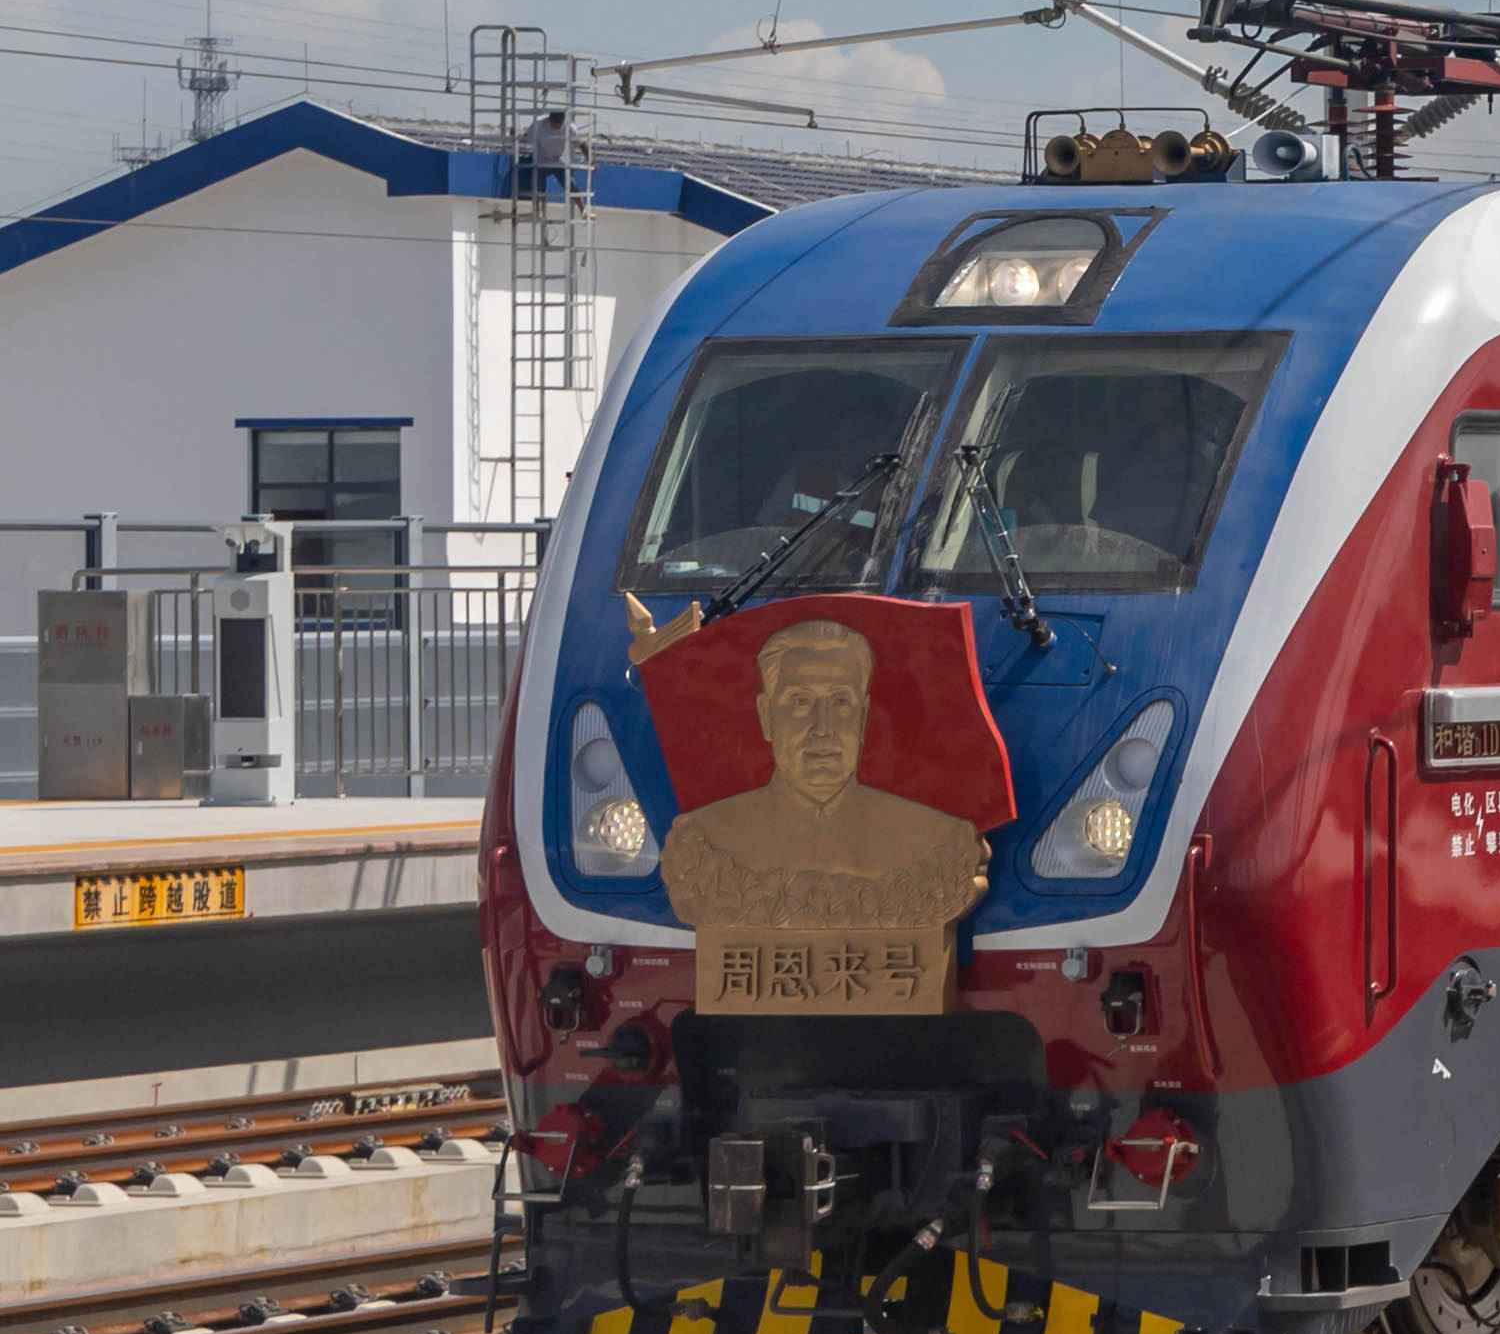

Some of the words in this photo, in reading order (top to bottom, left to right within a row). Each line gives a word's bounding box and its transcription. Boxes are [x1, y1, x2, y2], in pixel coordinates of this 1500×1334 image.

[83, 878, 237, 920] 禁止跨越股道
[715, 944, 925, 1002] 周恩来号
